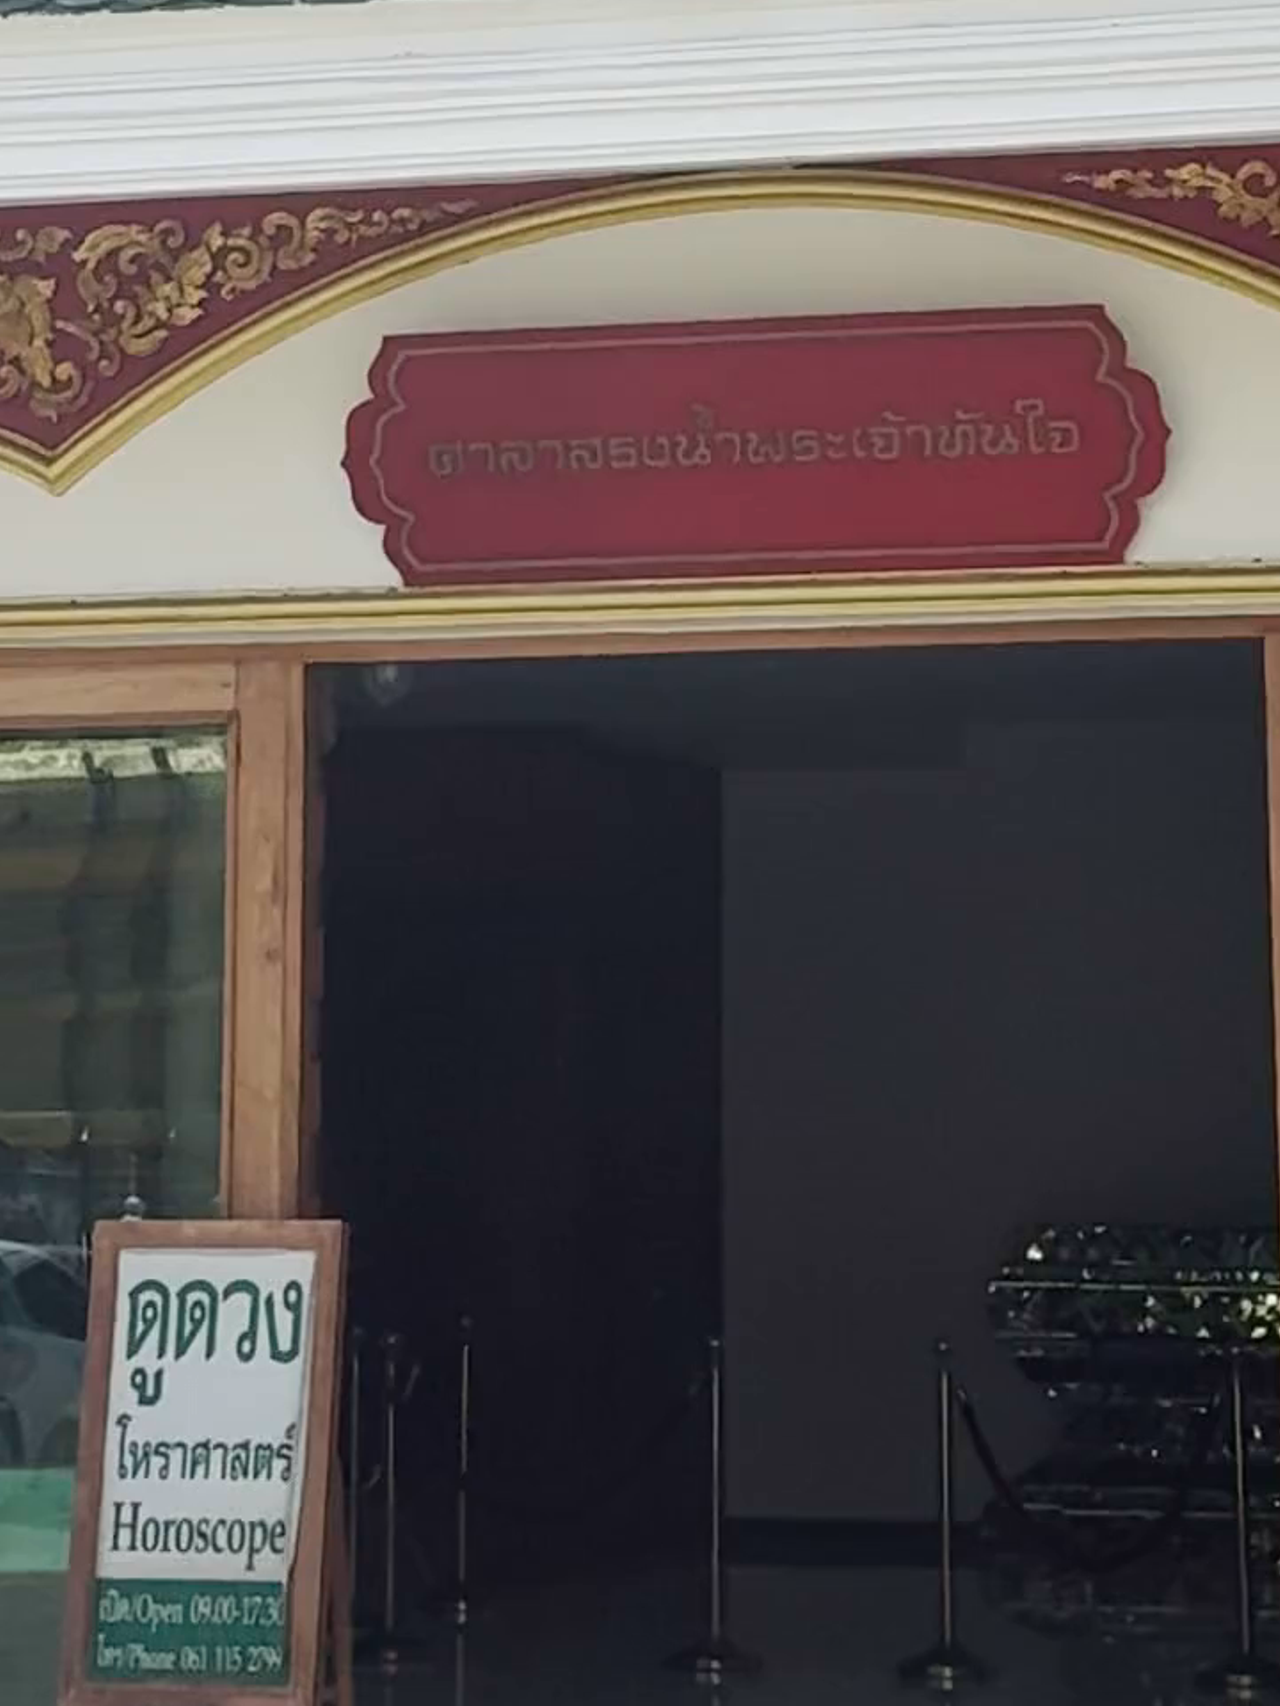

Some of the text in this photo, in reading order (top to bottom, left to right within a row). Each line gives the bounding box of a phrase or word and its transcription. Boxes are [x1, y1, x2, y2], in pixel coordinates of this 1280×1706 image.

[125, 1278, 303, 1407] ดูดวง
[115, 1414, 297, 1483] โหราศาสตร์
[111, 1501, 286, 1571] Horoscope
